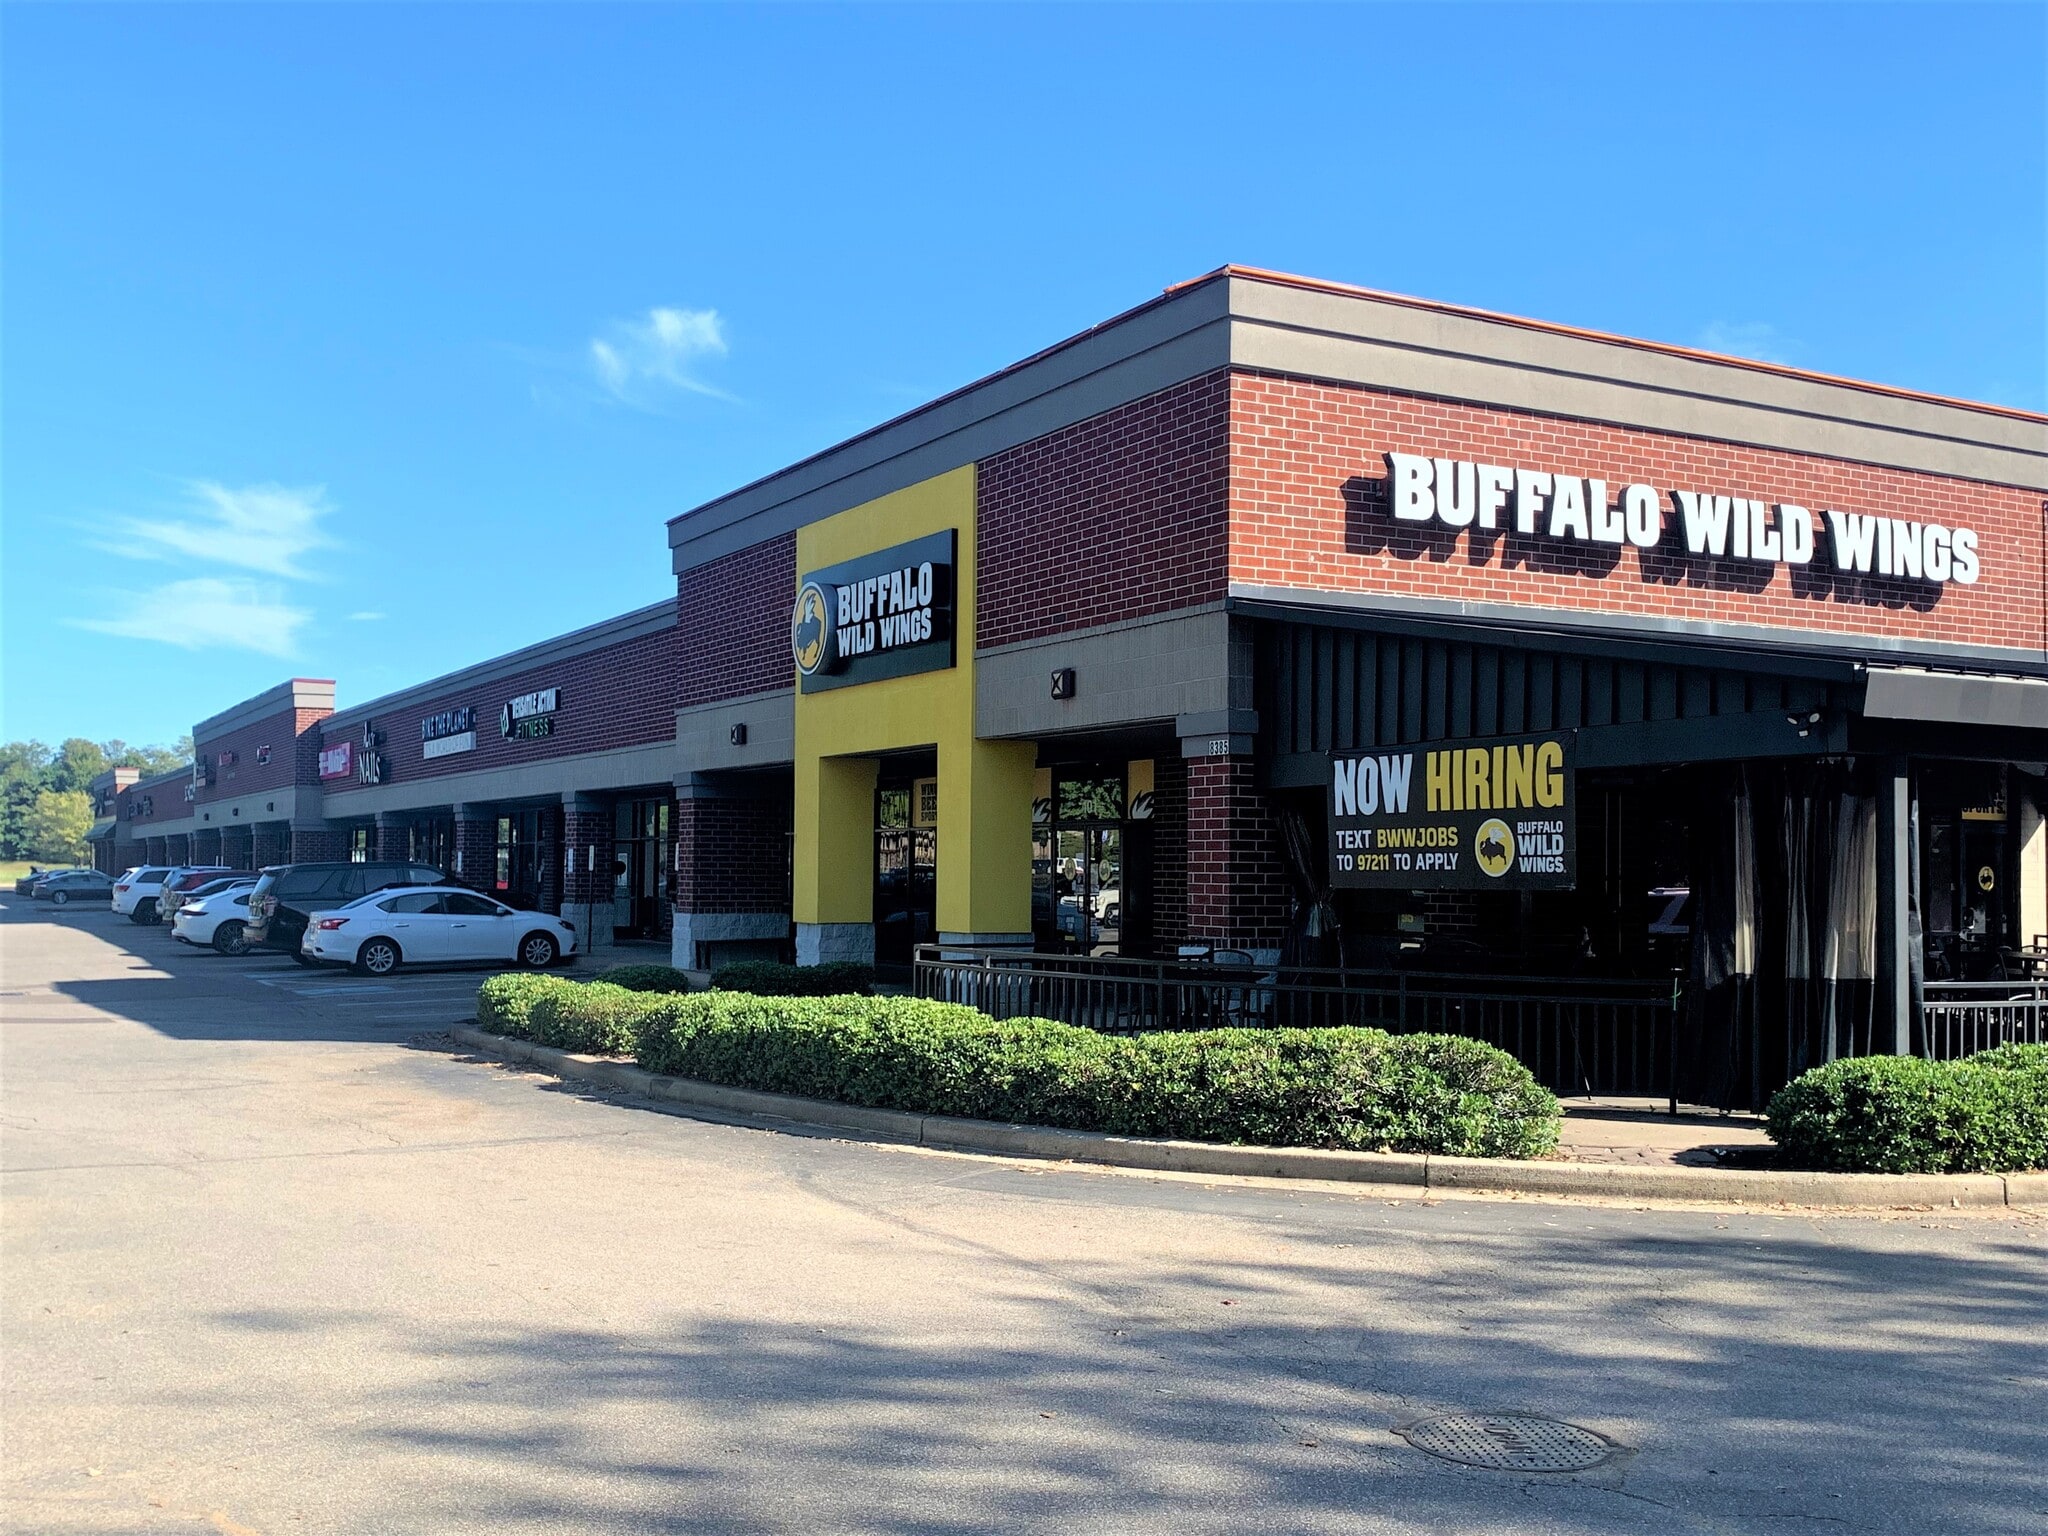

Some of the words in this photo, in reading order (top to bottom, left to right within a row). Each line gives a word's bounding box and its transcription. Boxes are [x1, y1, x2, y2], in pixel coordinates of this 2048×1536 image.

[1390, 452, 1660, 547] BUFFALO
[1675, 490, 1813, 564] WILD
[1825, 510, 1980, 585] WINGS
[837, 561, 932, 626] BUFFALO
[836, 621, 875, 658] WILD
[879, 607, 932, 648] WINGS
[517, 717, 549, 739] FITNESS
[1210, 741, 1228, 754] 8385
[359, 750, 380, 784] NAILS
[1333, 753, 1413, 816] NOW
[1426, 741, 1564, 812] HIRING
[1336, 830, 1372, 849] TEXT
[1377, 827, 1459, 848] BWWJOBS
[1517, 820, 1564, 834] BUFFALO
[1517, 835, 1564, 856] WILD
[1336, 854, 1354, 871] TO
[1357, 854, 1390, 871] 97211
[1393, 853, 1411, 871] TO
[1415, 853, 1459, 871] APPLY
[1518, 856, 1564, 873] WINGS
